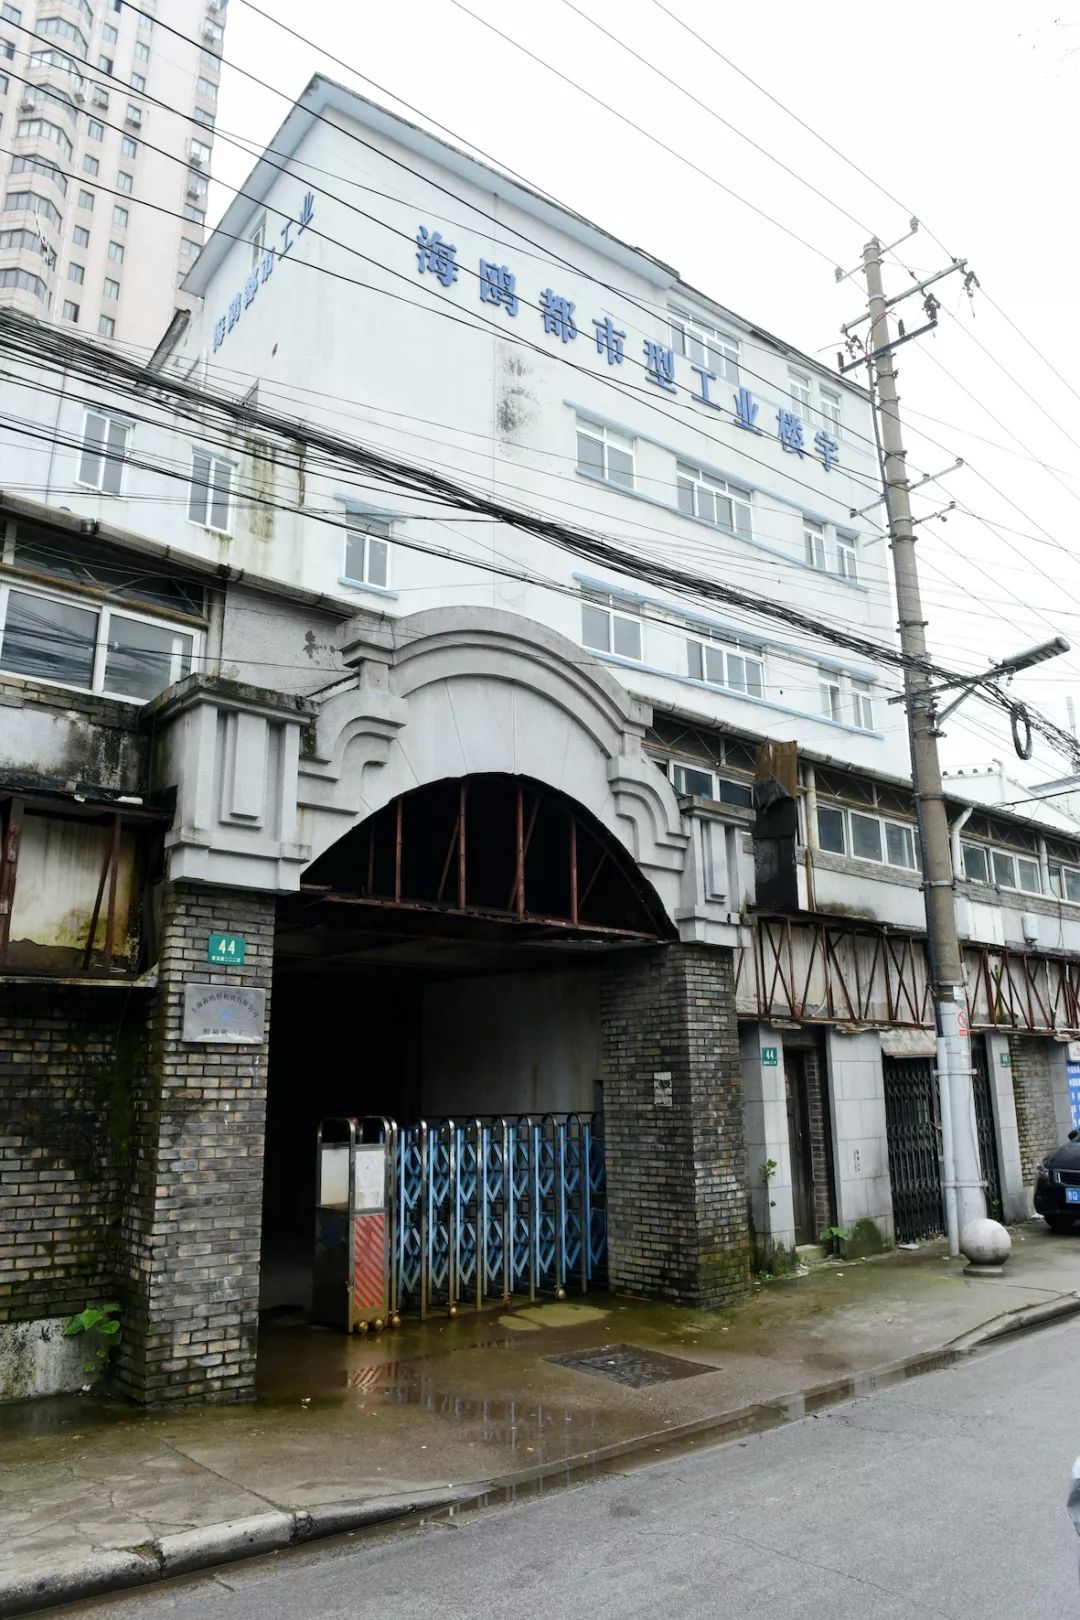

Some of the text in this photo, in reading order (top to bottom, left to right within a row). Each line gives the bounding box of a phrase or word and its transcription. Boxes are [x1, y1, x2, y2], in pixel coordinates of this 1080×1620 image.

[415, 224, 840, 473] 海鸥都市型工业楼宇
[218, 939, 236, 955] 44
[766, 1049, 774, 1060] 44
